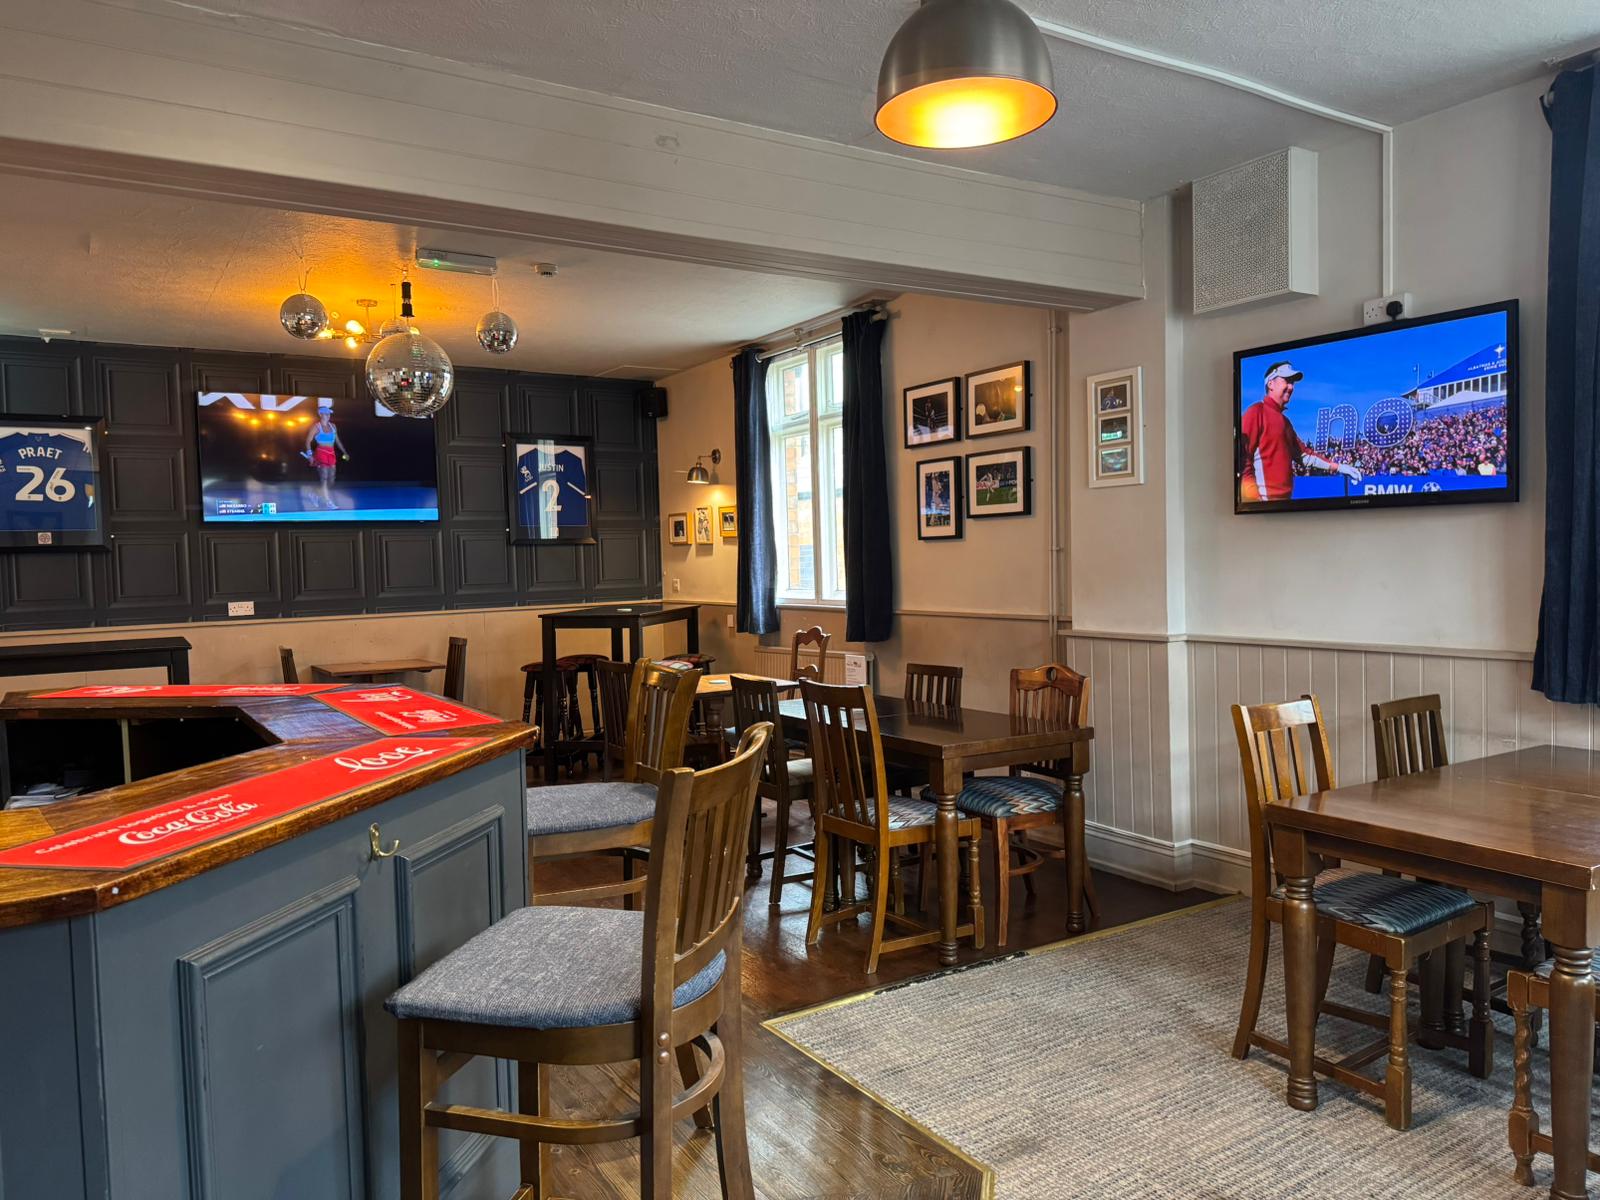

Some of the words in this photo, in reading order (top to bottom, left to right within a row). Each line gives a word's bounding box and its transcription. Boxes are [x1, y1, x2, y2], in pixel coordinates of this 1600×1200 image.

[17, 446, 63, 460] PRAET
[540, 464, 564, 472] JUSTIN
[15, 465, 76, 503] 26
[1364, 484, 1414, 496] BMW
[542, 479, 562, 512] 2
